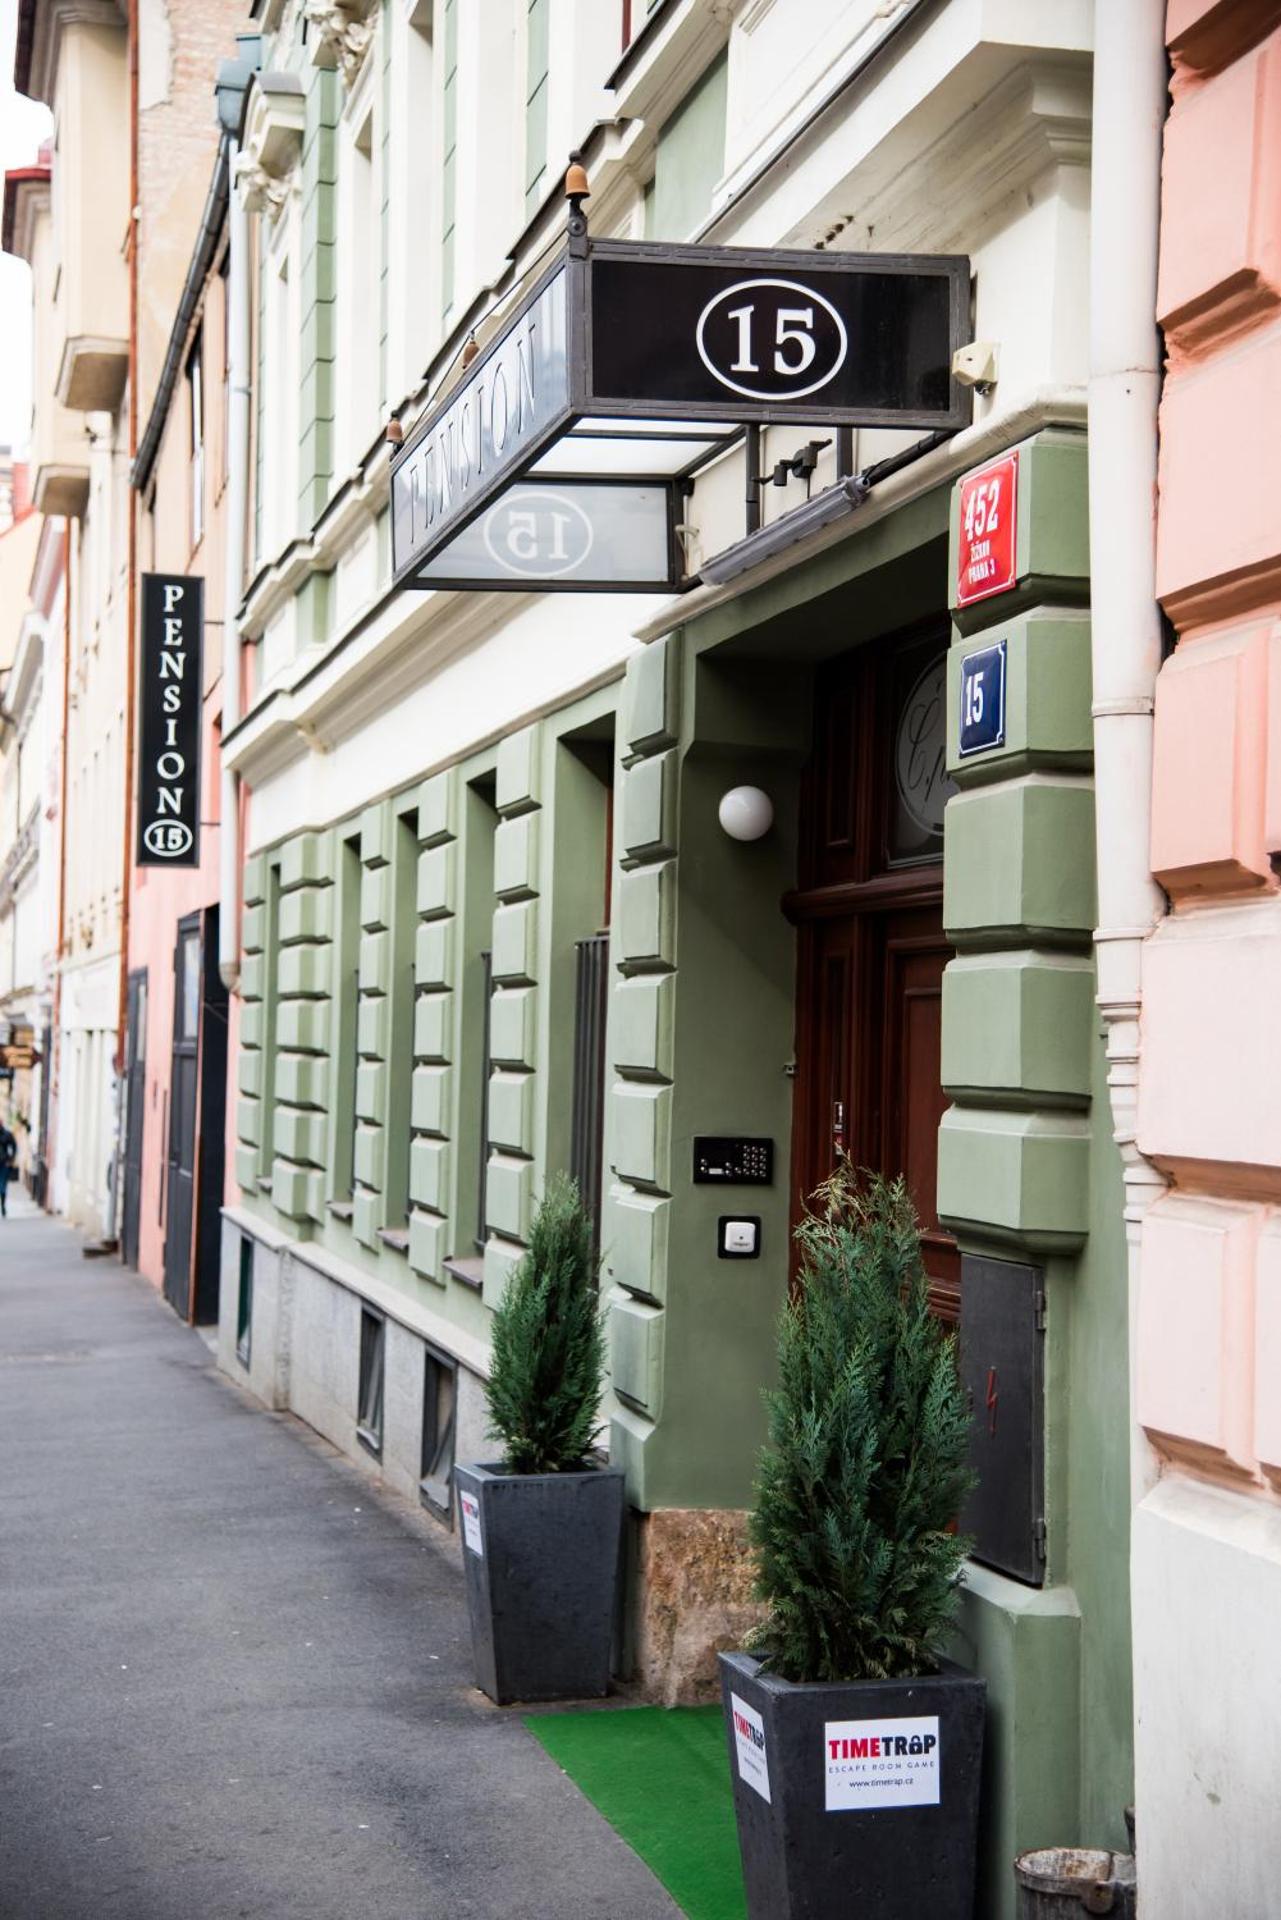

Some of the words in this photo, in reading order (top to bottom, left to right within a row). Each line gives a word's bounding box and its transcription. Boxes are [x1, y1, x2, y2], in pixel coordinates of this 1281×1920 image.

[728, 304, 816, 375] 15
[964, 479, 999, 542] 452
[989, 558, 996, 575] 3
[157, 585, 186, 815] PENSION
[965, 671, 984, 726] 15
[153, 827, 183, 851] 15
[828, 1734, 937, 1760] TIMETRAP
[828, 1764, 867, 1774] ESCAPE
[872, 1763, 902, 1771] ROOM
[907, 1760, 935, 1769] GAME
